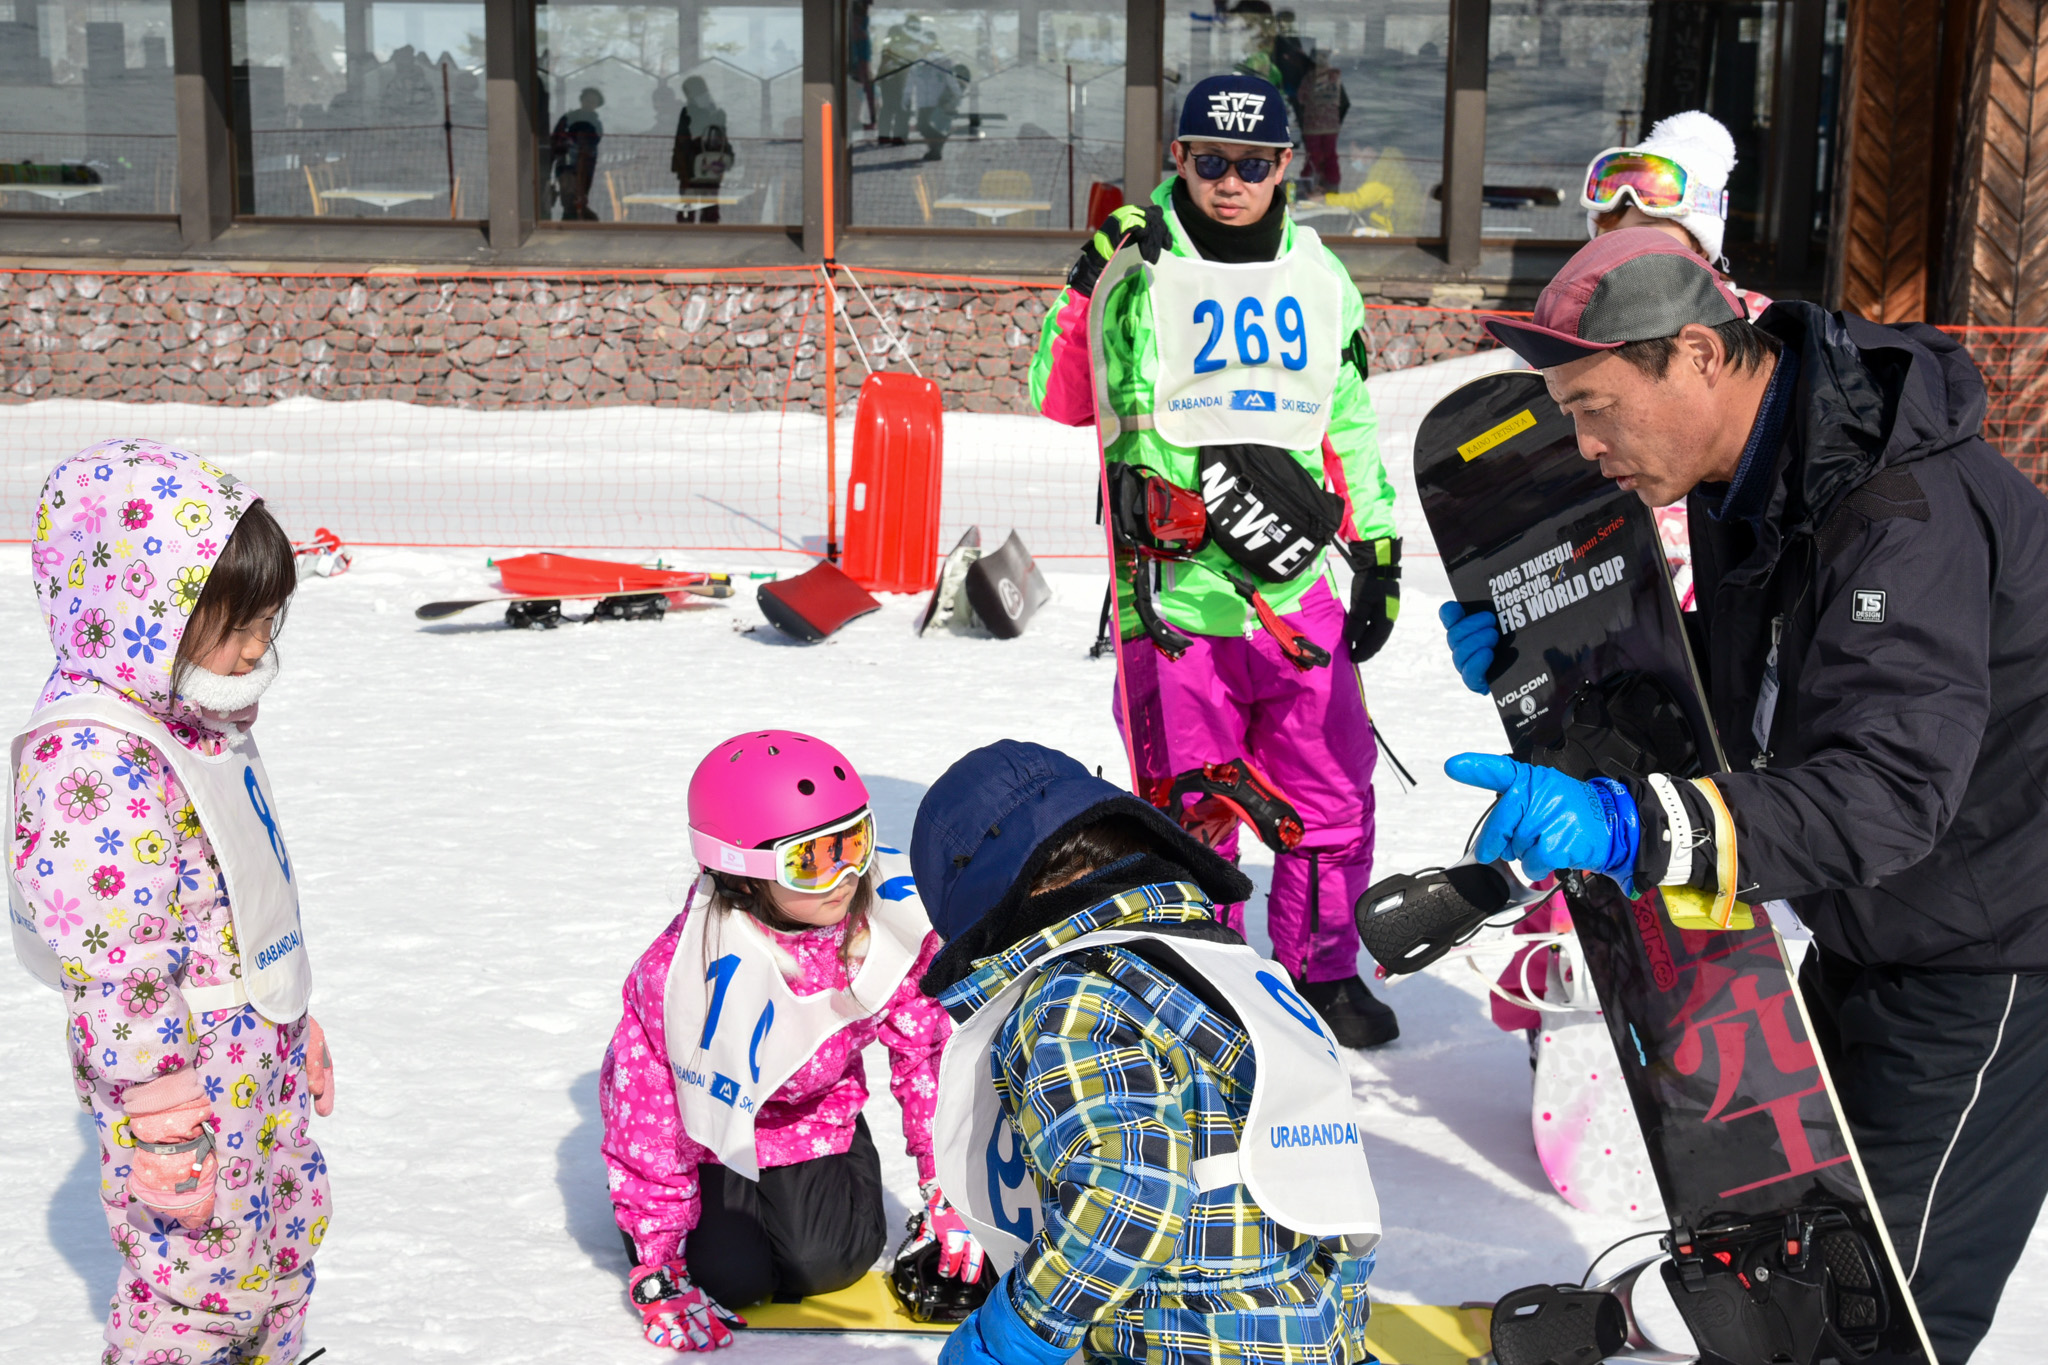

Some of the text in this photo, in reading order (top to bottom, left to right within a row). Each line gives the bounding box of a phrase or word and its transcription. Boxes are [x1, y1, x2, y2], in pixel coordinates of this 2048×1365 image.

[1193, 295, 1308, 375] 269
[1168, 396, 1223, 412] URABANDAI
[1282, 399, 1295, 411] SKI
[1466, 417, 1528, 455] KAINO TETSUYA
[1488, 515, 1625, 596] 2005 TAKEFUJI Japan Series
[1492, 574, 1551, 612] Freestyle
[1497, 555, 1626, 635] FIS WORLD CUP
[1857, 593, 1882, 611] TS
[1496, 672, 1549, 708] VOLCOM
[1529, 713, 1538, 721] TO
[254, 930, 300, 971] URABANDAI
[1270, 1122, 1359, 1149] URABANDAI
